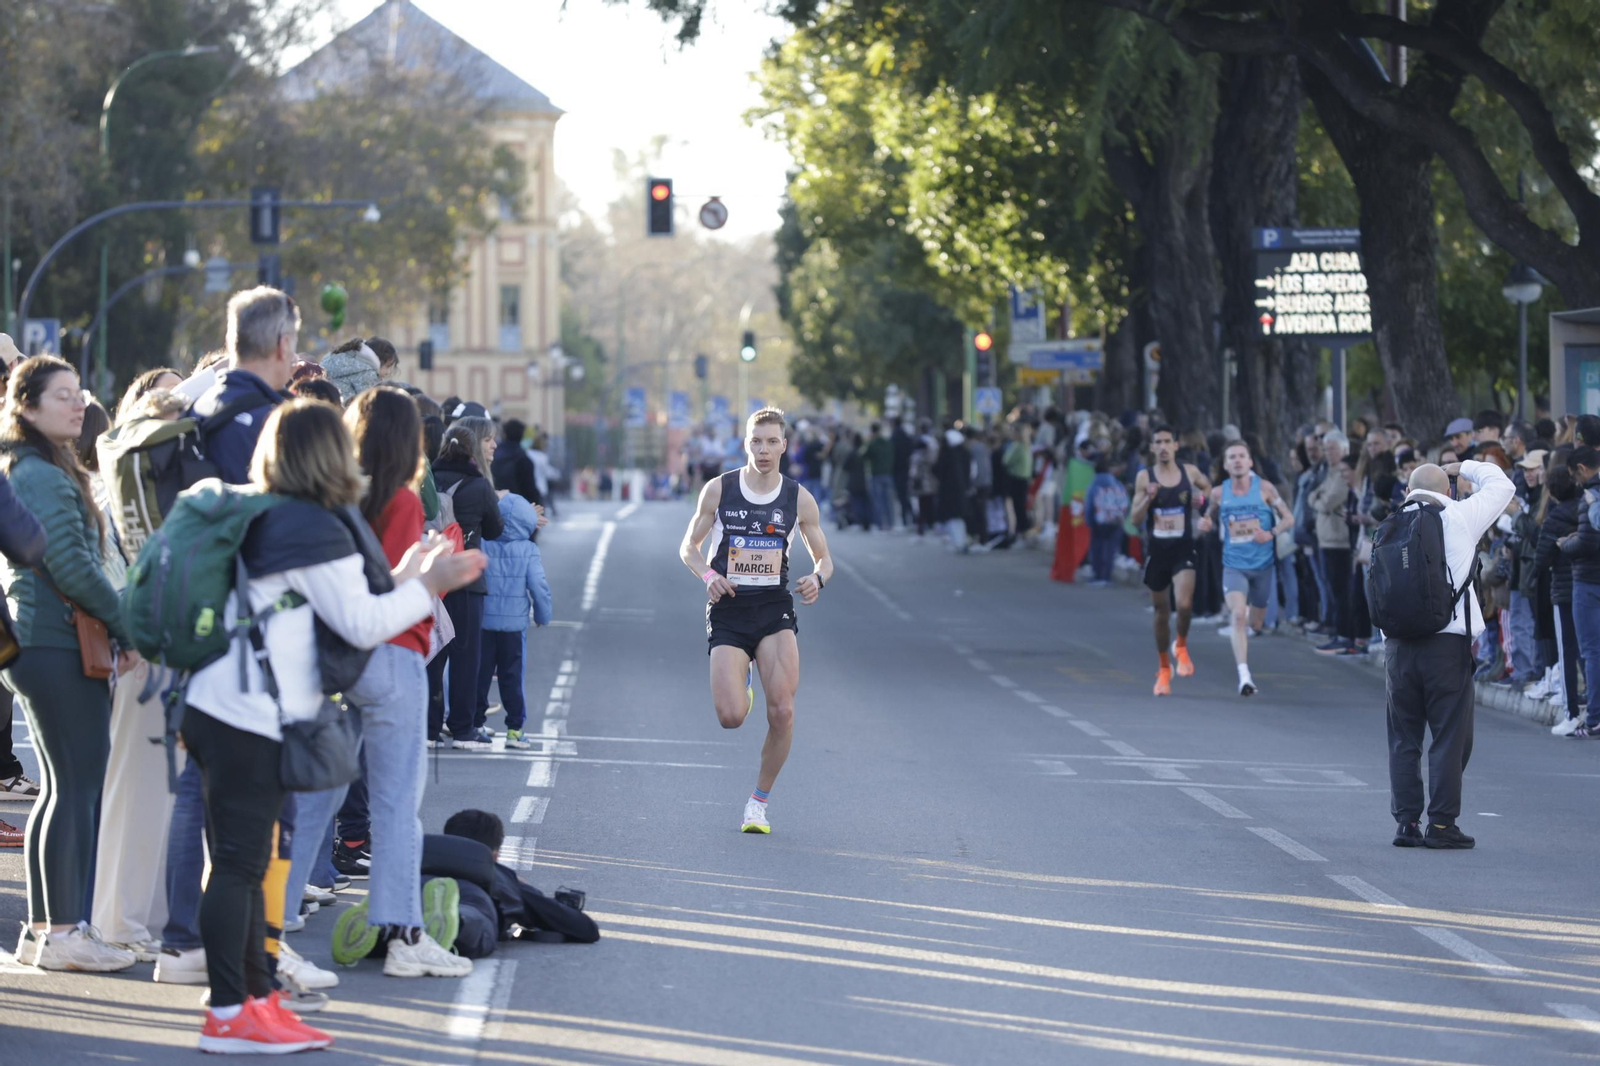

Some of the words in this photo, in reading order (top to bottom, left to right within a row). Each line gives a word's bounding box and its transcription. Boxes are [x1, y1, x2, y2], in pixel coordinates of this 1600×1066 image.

[1262, 229, 1279, 248] P
[1320, 252, 1361, 272] CUBA
[1274, 273, 1302, 293] LOS
[1303, 273, 1368, 293] REMEDIO
[1274, 293, 1333, 313] BUENOS
[1334, 293, 1371, 313] AIRE
[1274, 313, 1337, 334] AVENIDA
[1401, 546, 1409, 569] THULE
[734, 563, 775, 574] MARCEL
